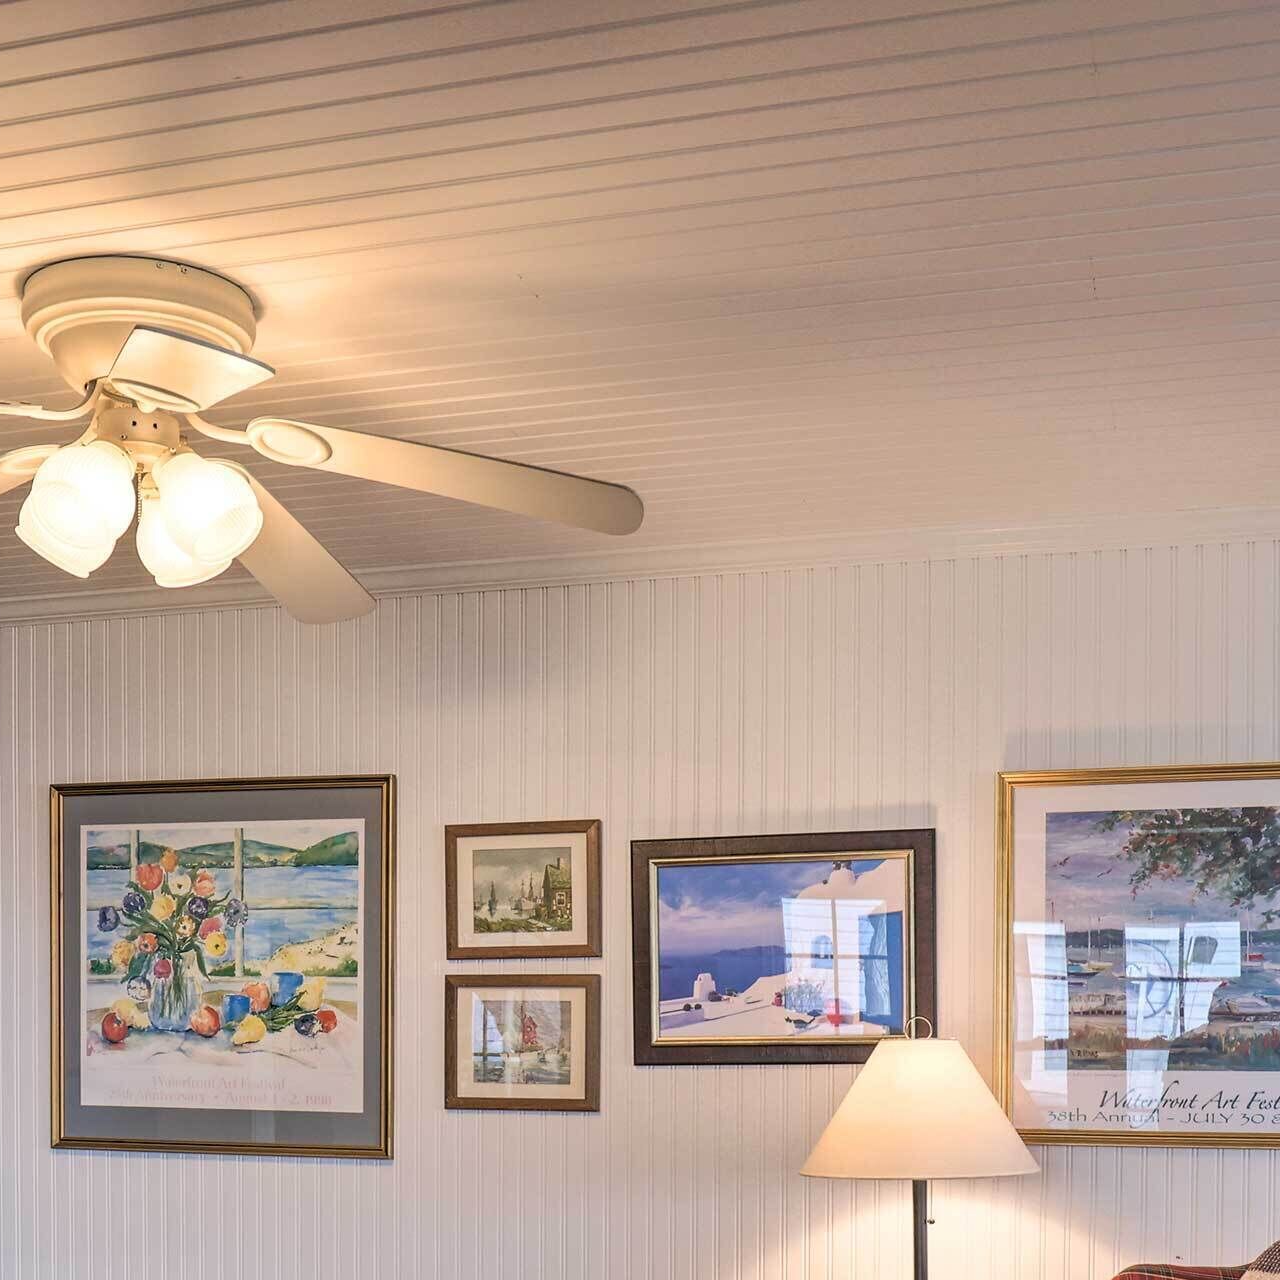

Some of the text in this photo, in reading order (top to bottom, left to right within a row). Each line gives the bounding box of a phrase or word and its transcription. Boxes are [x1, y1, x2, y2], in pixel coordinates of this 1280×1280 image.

[1047, 1107, 1087, 1123] 38th
[1092, 1109, 1160, 1123] Annual
[1179, 1112, 1234, 1124] JULY
[1239, 1113, 1265, 1126] 30
[1099, 1080, 1199, 1129] Waterfront
[1201, 1090, 1240, 1111] Art
